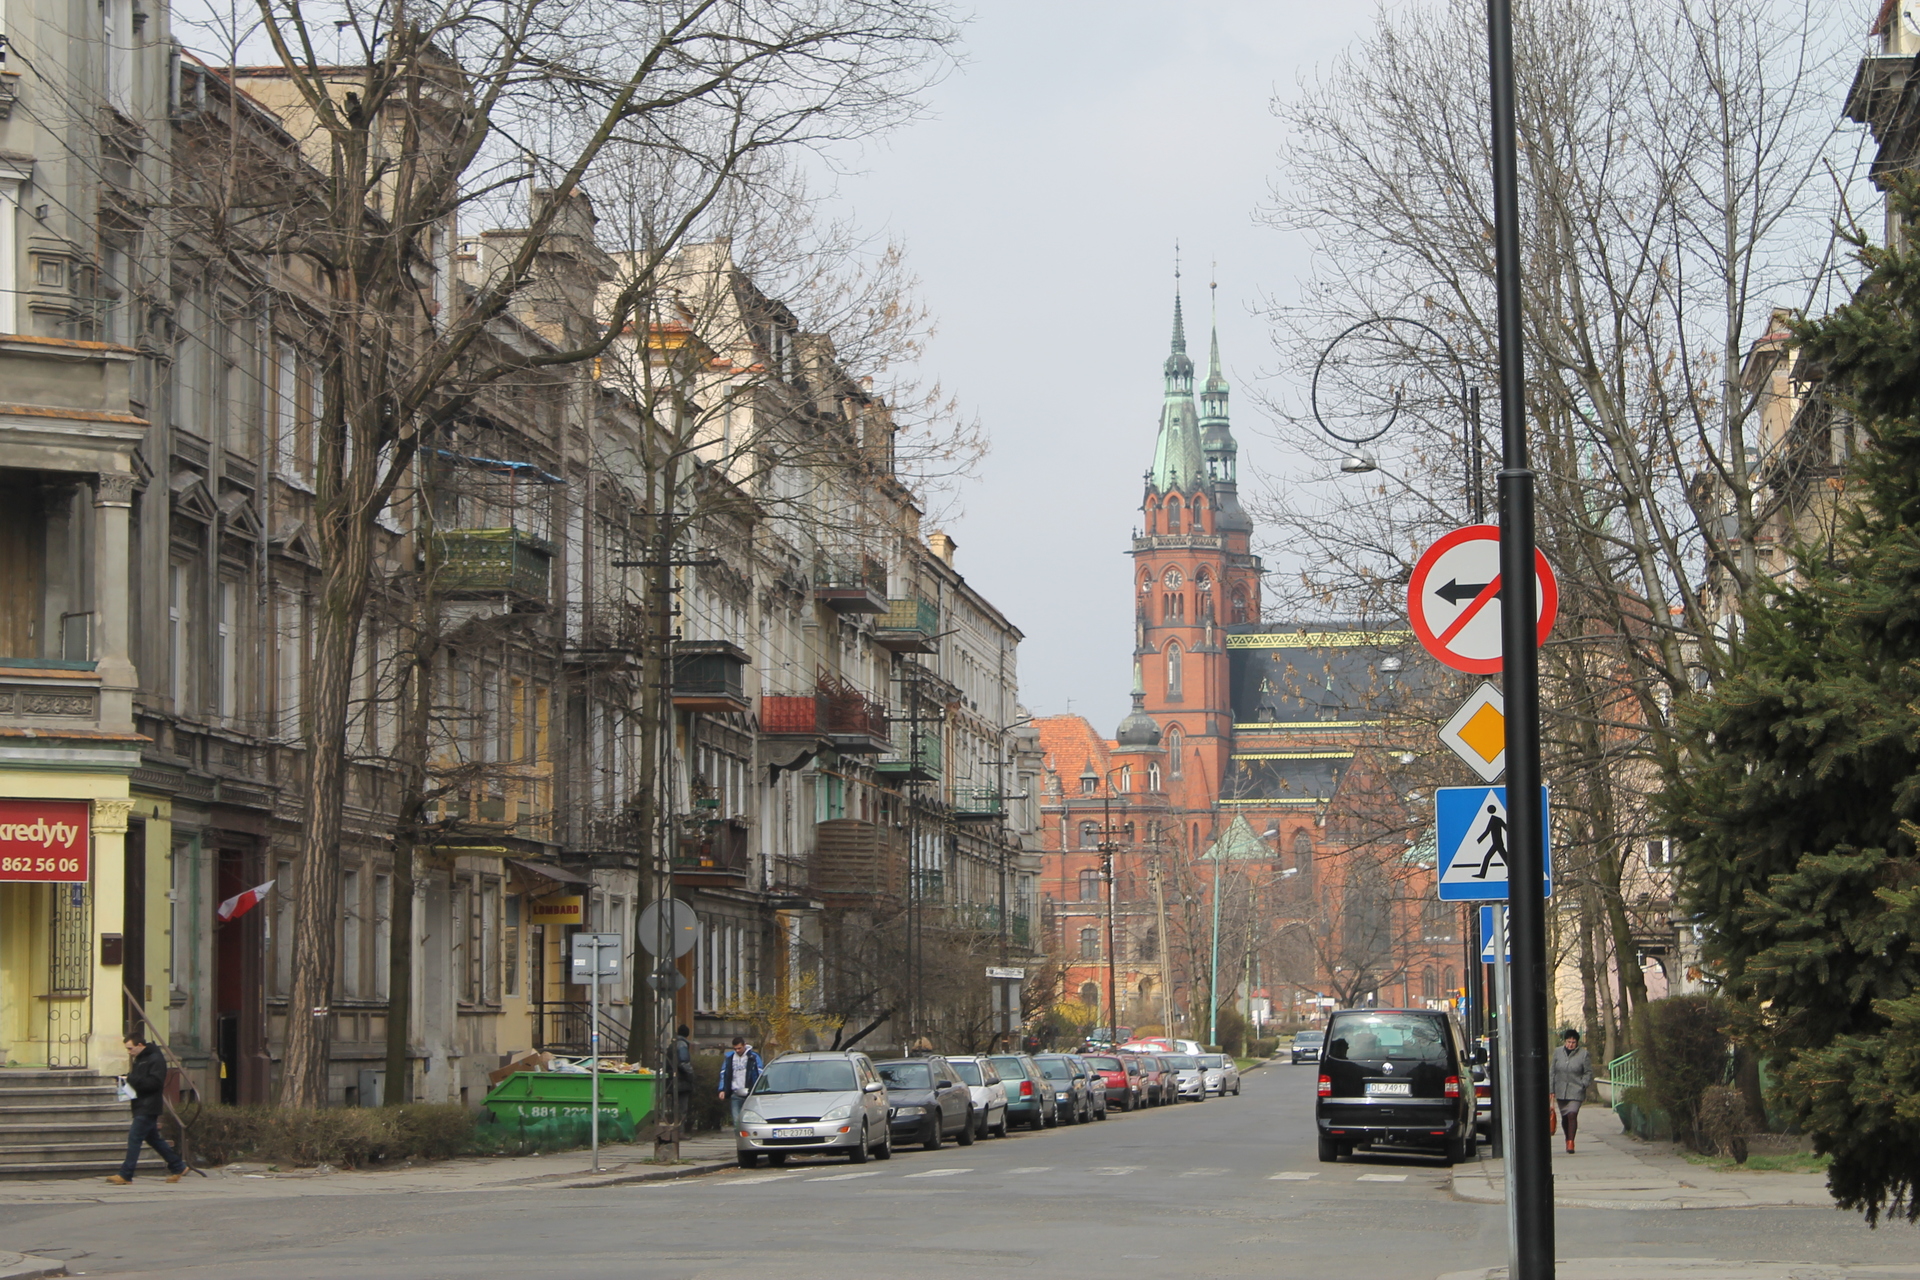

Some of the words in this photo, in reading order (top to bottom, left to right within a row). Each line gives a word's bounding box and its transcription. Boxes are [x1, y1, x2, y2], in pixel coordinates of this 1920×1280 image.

[0, 817, 79, 849] kredyty
[1, 857, 32, 872] 862
[35, 857, 56, 873] 56
[58, 858, 79, 873] 06
[533, 904, 579, 915] LOMBARD
[1371, 1083, 1382, 1092] DL
[1384, 1083, 1408, 1092] 74917
[531, 1106, 557, 1118] 881
